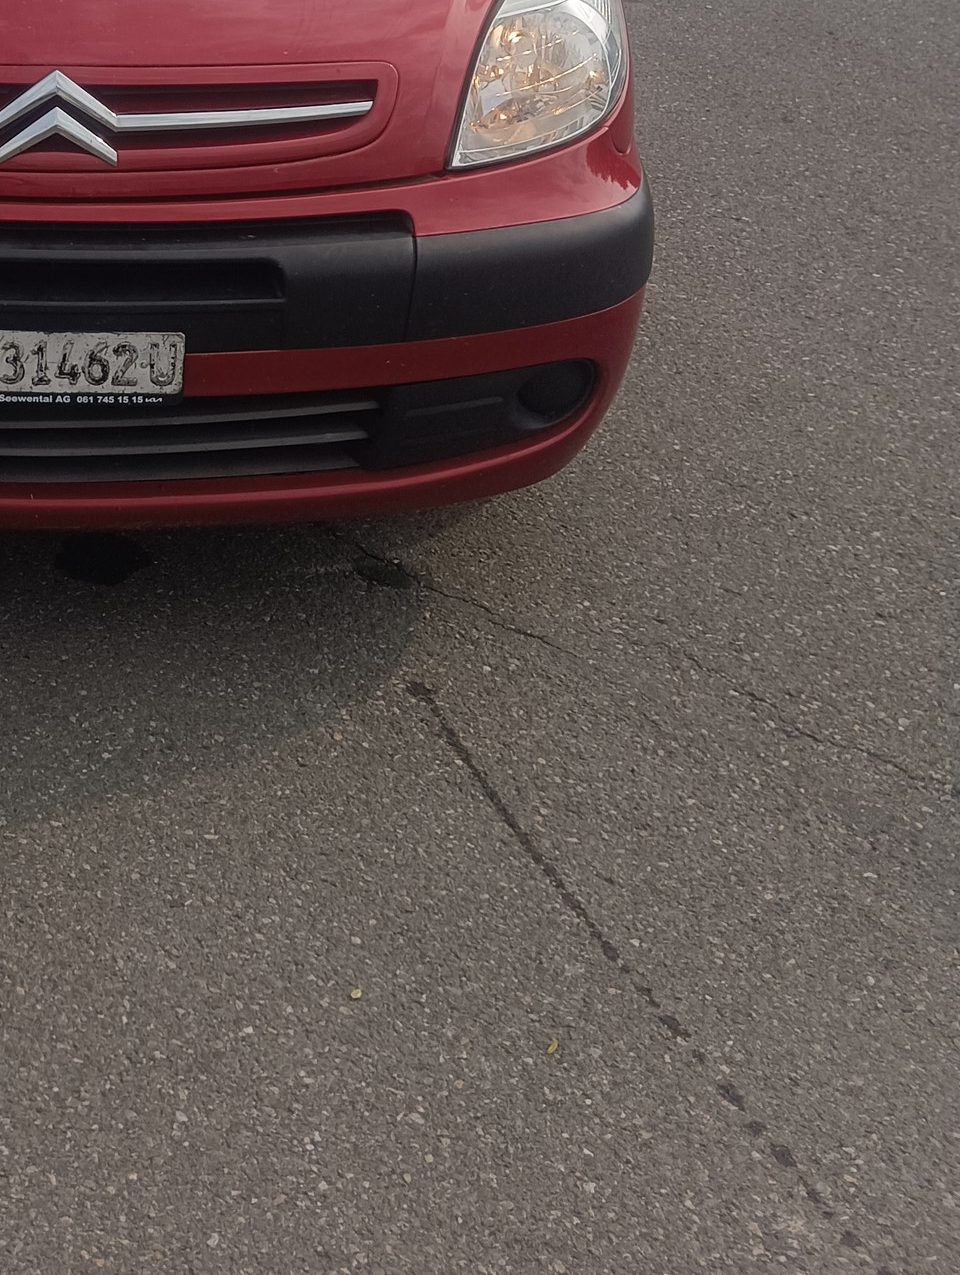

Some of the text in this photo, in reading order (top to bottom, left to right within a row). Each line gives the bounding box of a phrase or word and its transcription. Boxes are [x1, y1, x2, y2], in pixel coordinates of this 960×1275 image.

[55, 395, 71, 404] AG
[76, 395, 94, 404] 061
[96, 395, 115, 404] 745
[117, 395, 129, 404] 15
[131, 395, 144, 404] 15
